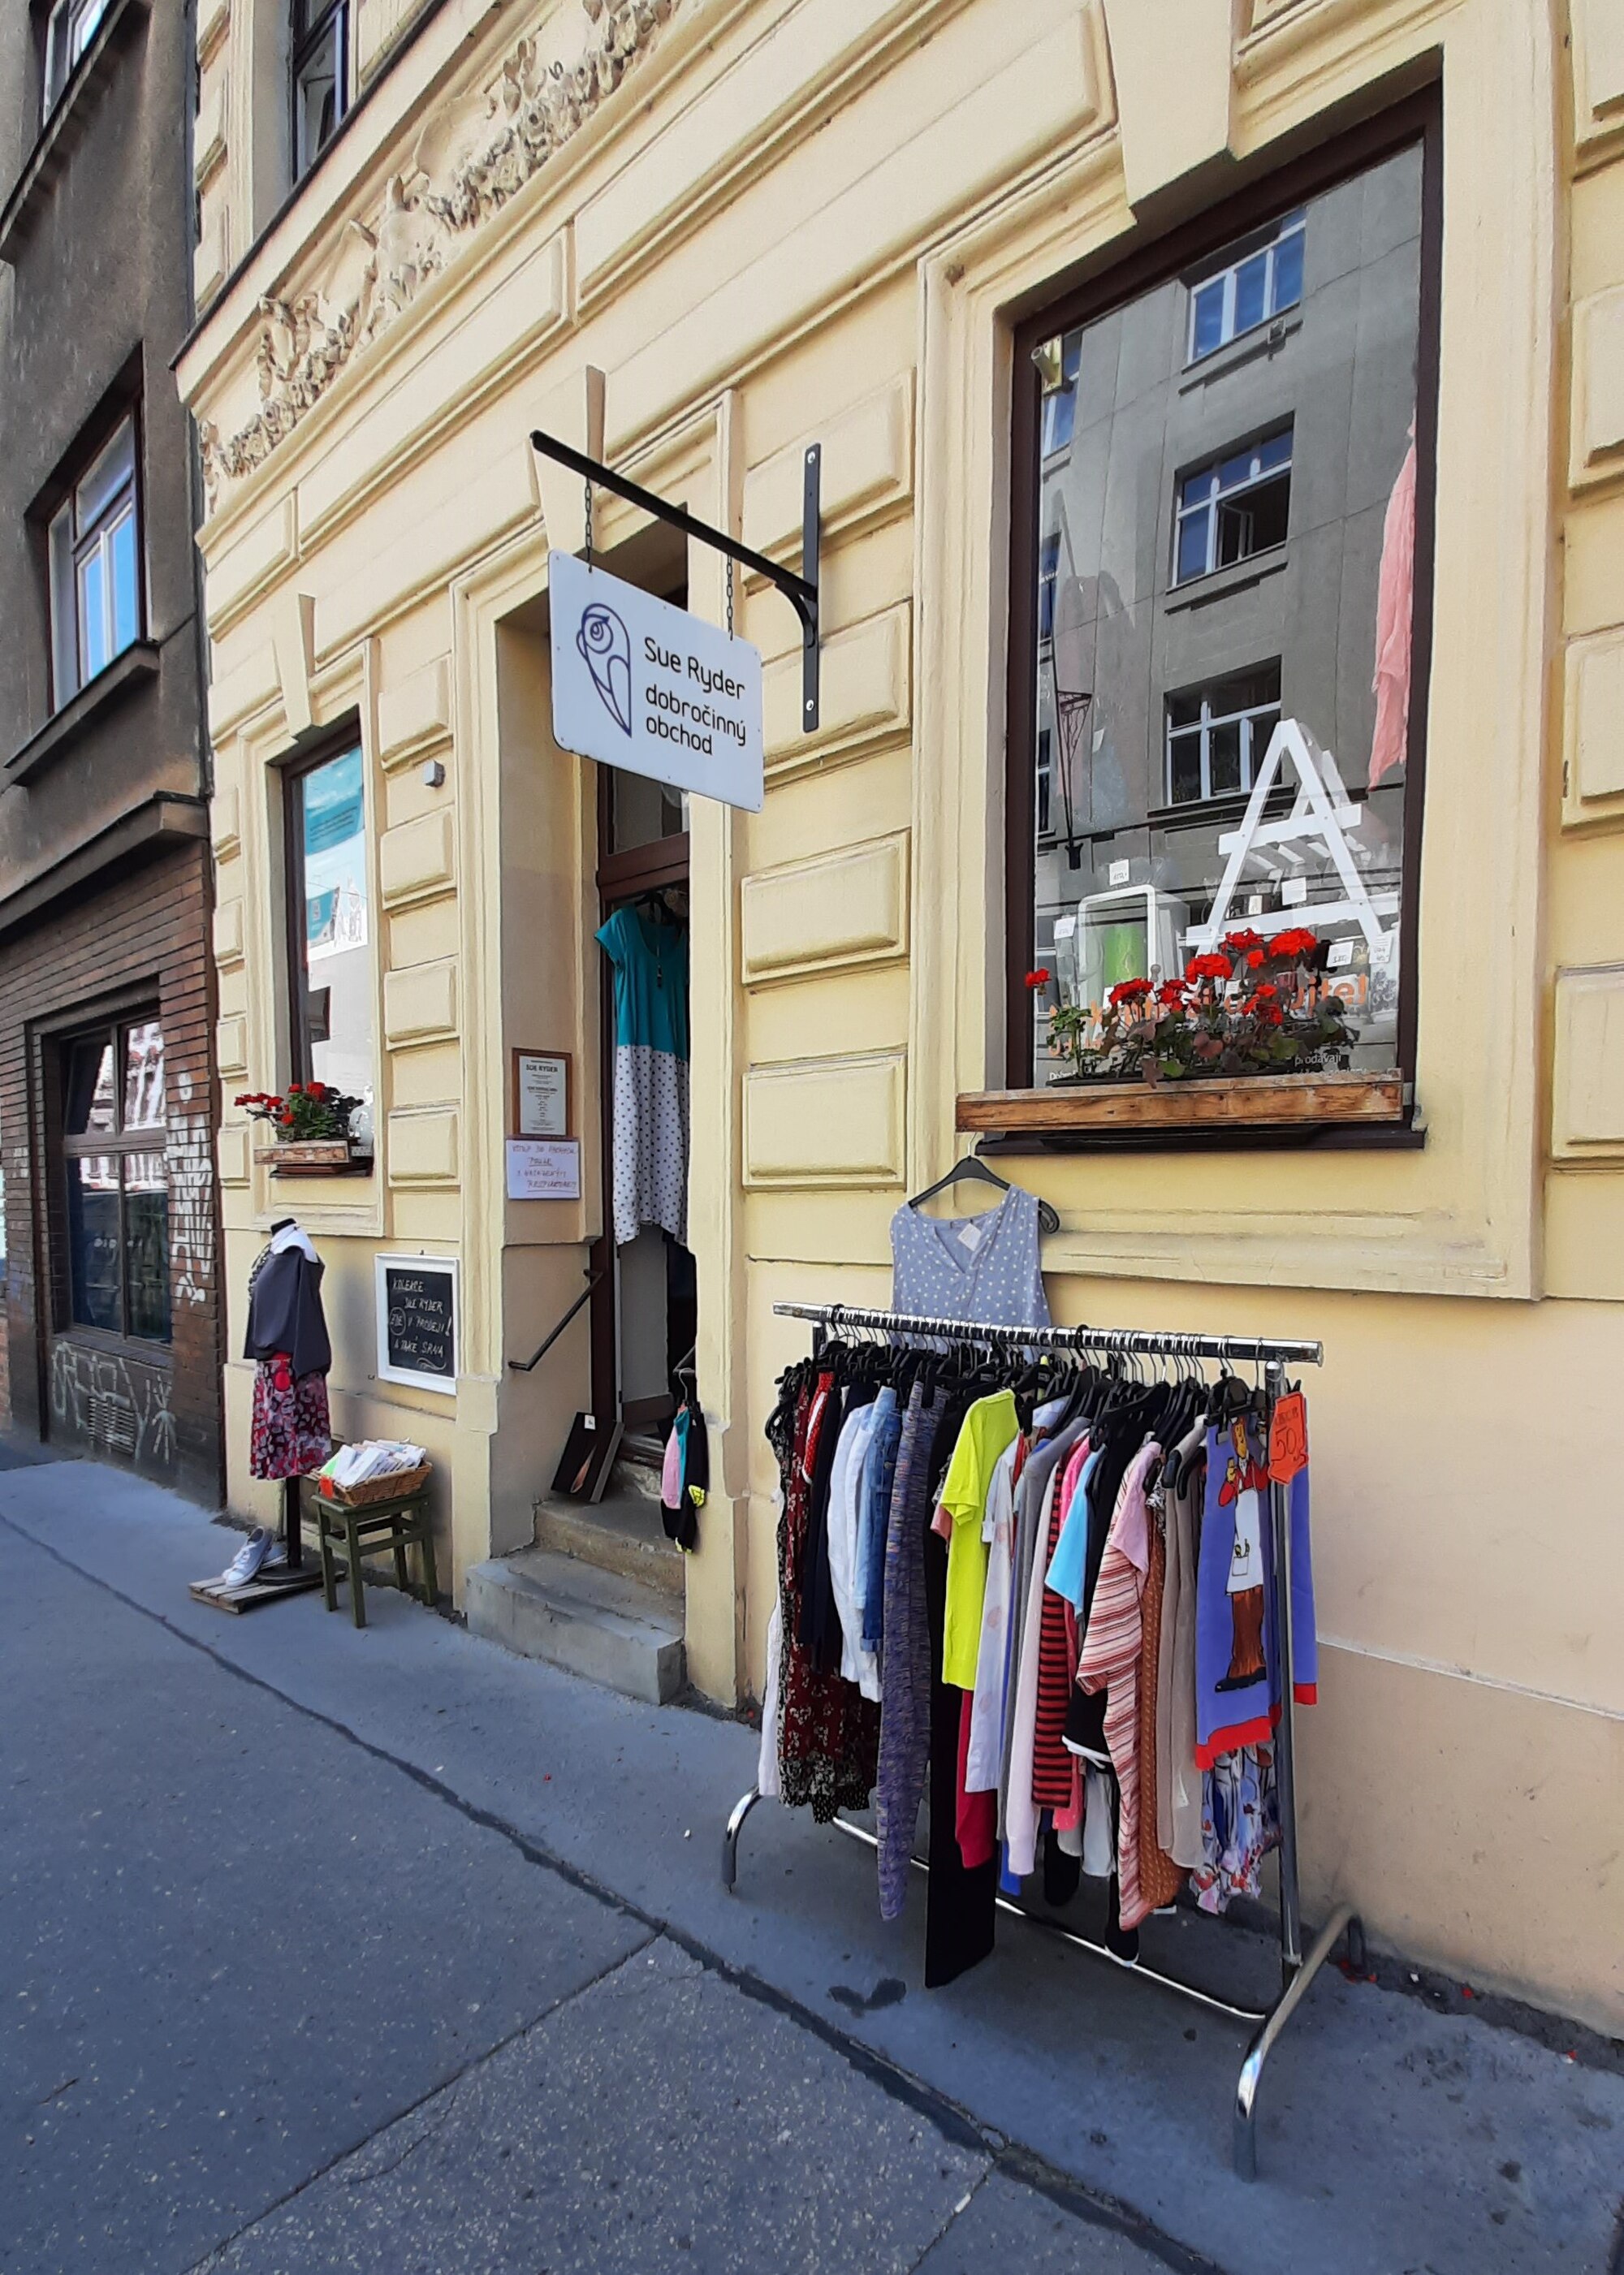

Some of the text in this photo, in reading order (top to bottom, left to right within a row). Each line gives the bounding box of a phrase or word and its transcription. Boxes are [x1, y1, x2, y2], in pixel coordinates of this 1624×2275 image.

[644, 636, 745, 700] Sue Ryder
[646, 683, 746, 746] dobročinný
[646, 714, 713, 755] obchod
